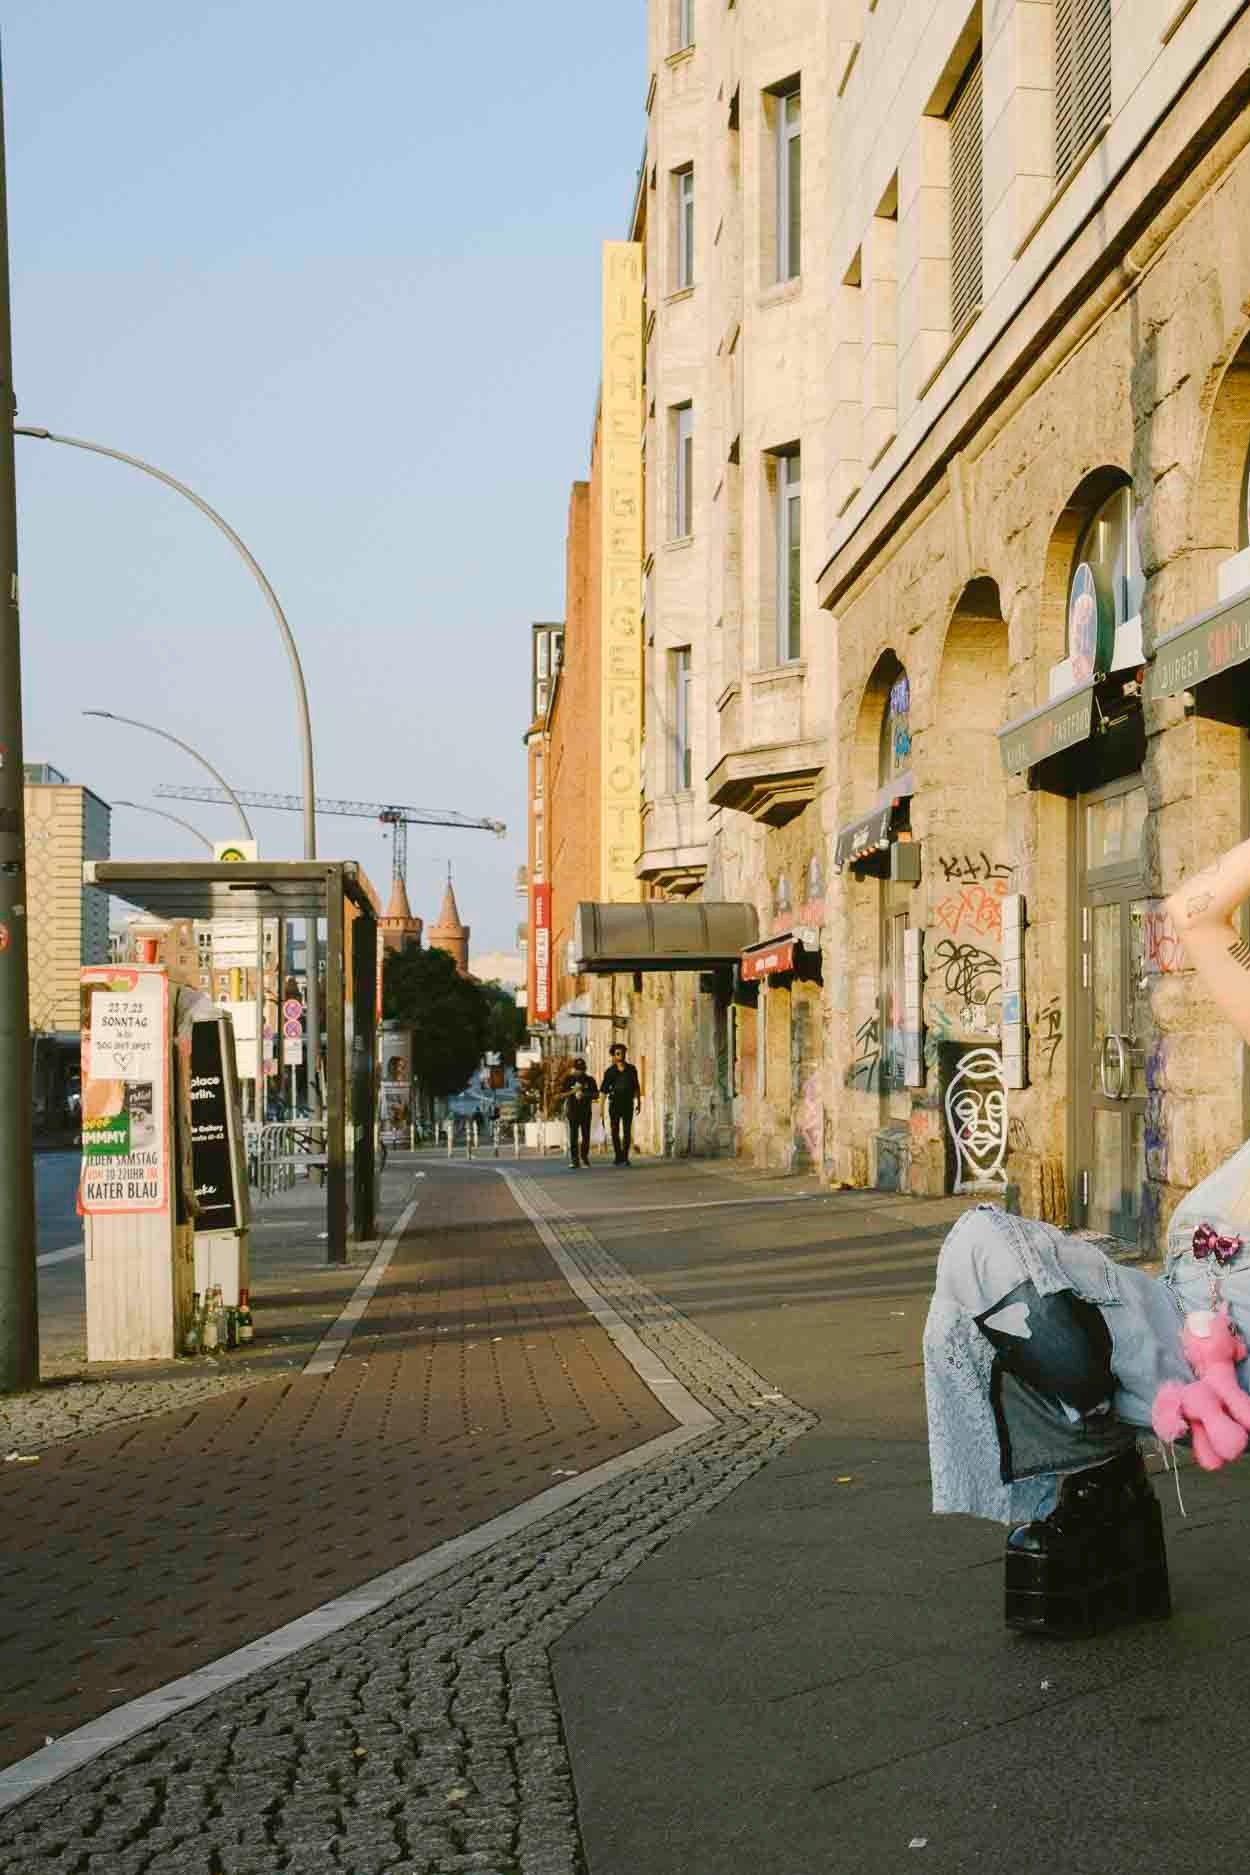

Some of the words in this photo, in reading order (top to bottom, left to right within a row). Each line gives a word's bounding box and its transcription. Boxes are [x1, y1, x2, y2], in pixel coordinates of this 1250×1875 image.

[101, 1015, 148, 1028] SONNTAG
[87, 1183, 124, 1199] KATER
[127, 1182, 158, 1199] BLAU
